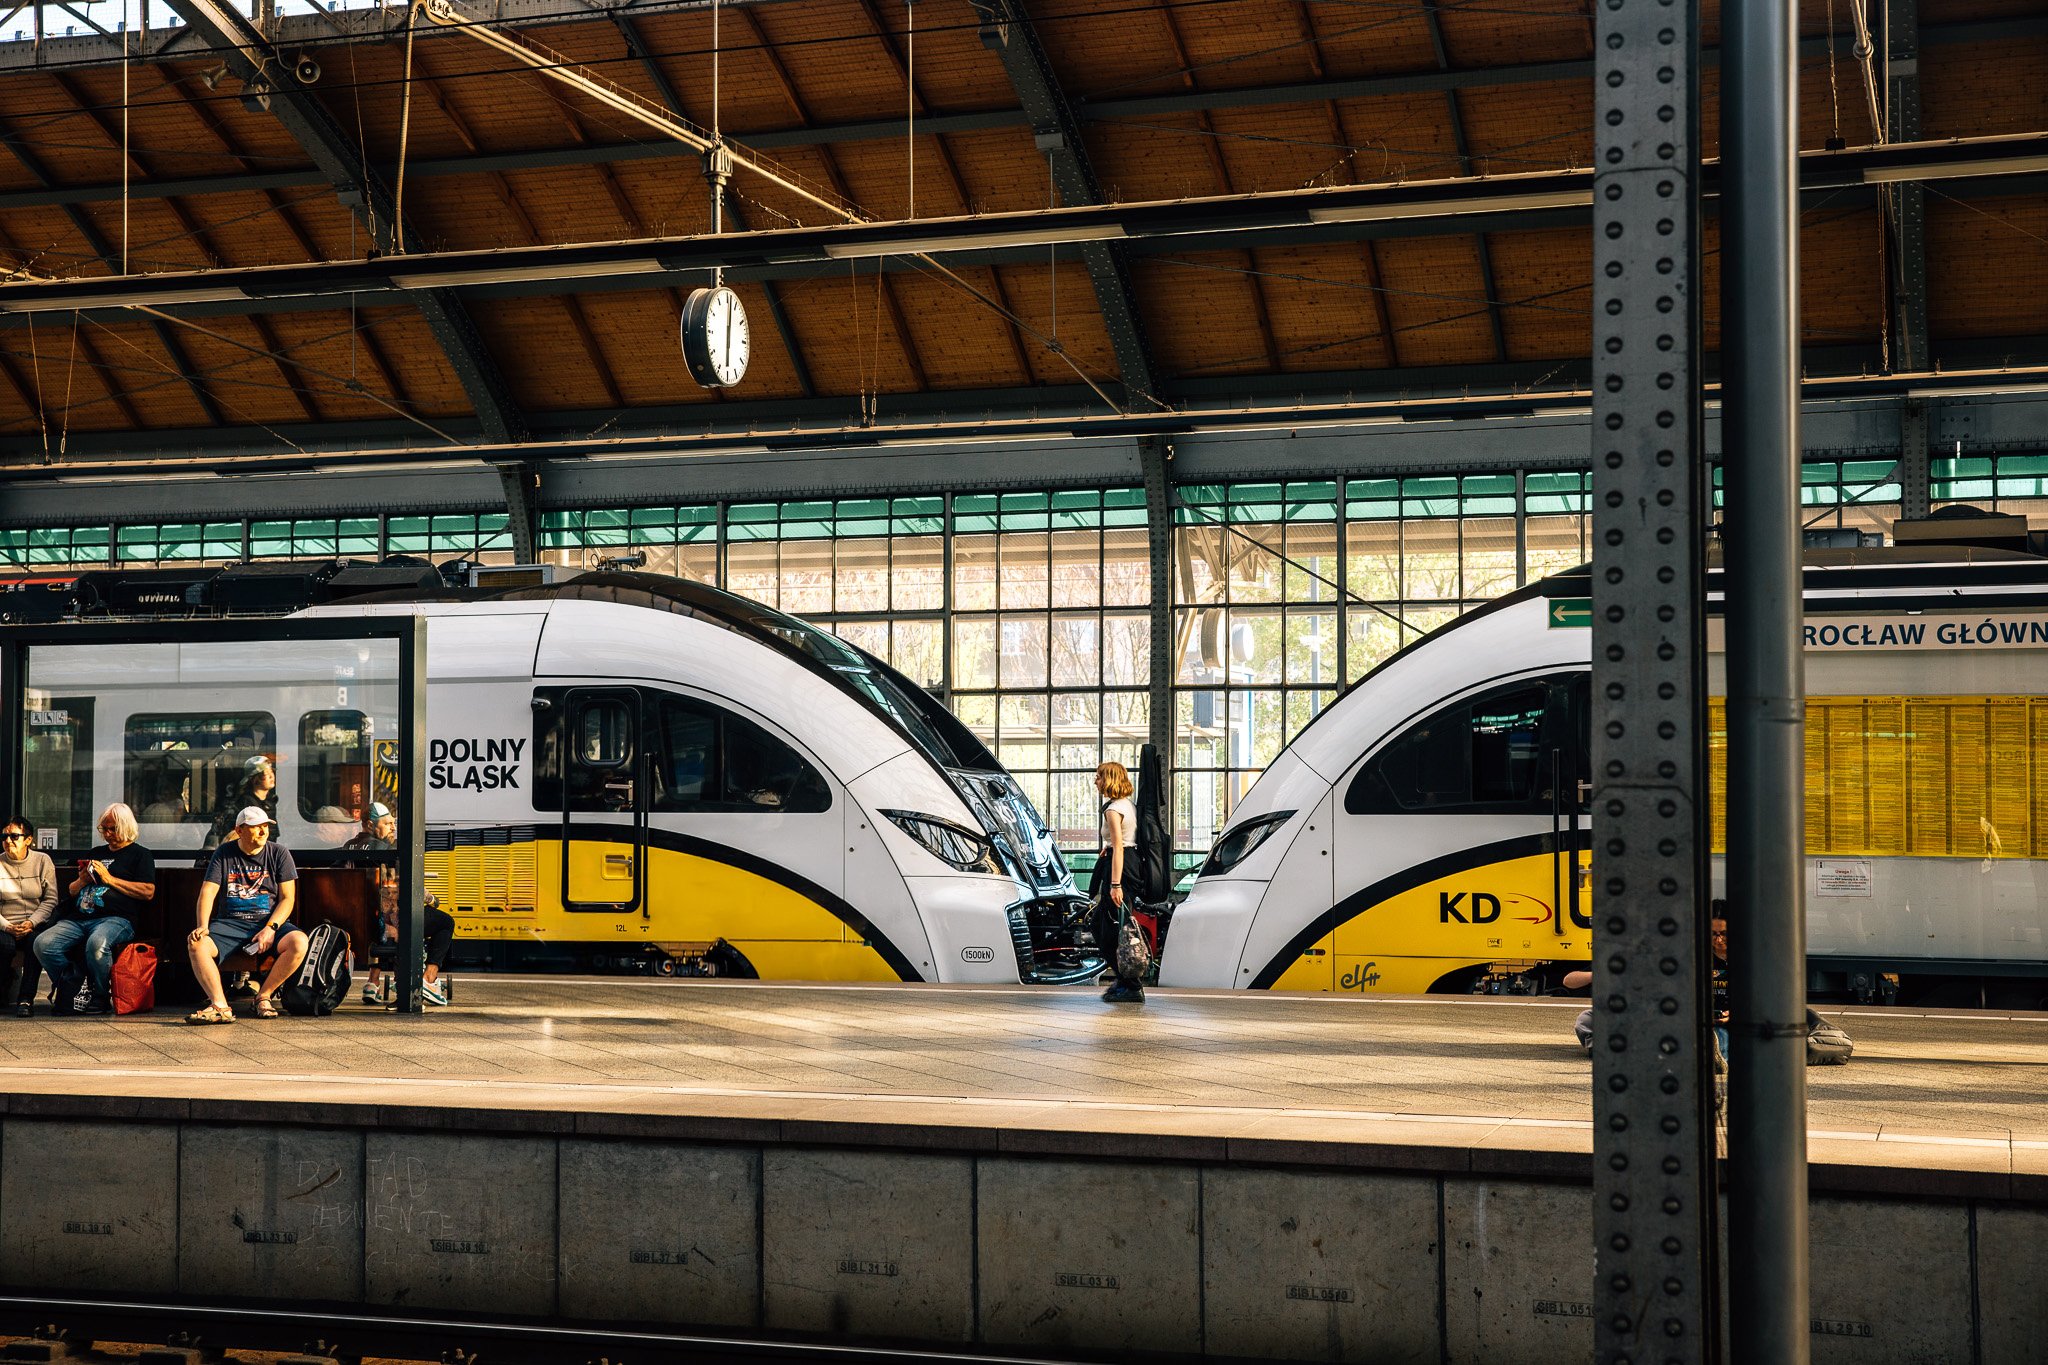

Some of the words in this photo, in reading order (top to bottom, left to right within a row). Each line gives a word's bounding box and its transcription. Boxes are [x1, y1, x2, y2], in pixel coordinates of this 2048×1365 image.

[1804, 623, 1926, 647] ROCŁAW
[1937, 617, 2048, 649] GŁÓWN
[429, 738, 527, 763] DOLNY
[428, 758, 520, 793] ŚLĄSK
[1440, 892, 1502, 924] KD
[615, 924, 627, 933] 12L
[965, 949, 991, 961] 1500kN
[1106, 1278, 1116, 1287] 10
[1810, 1321, 1822, 1332] IB
